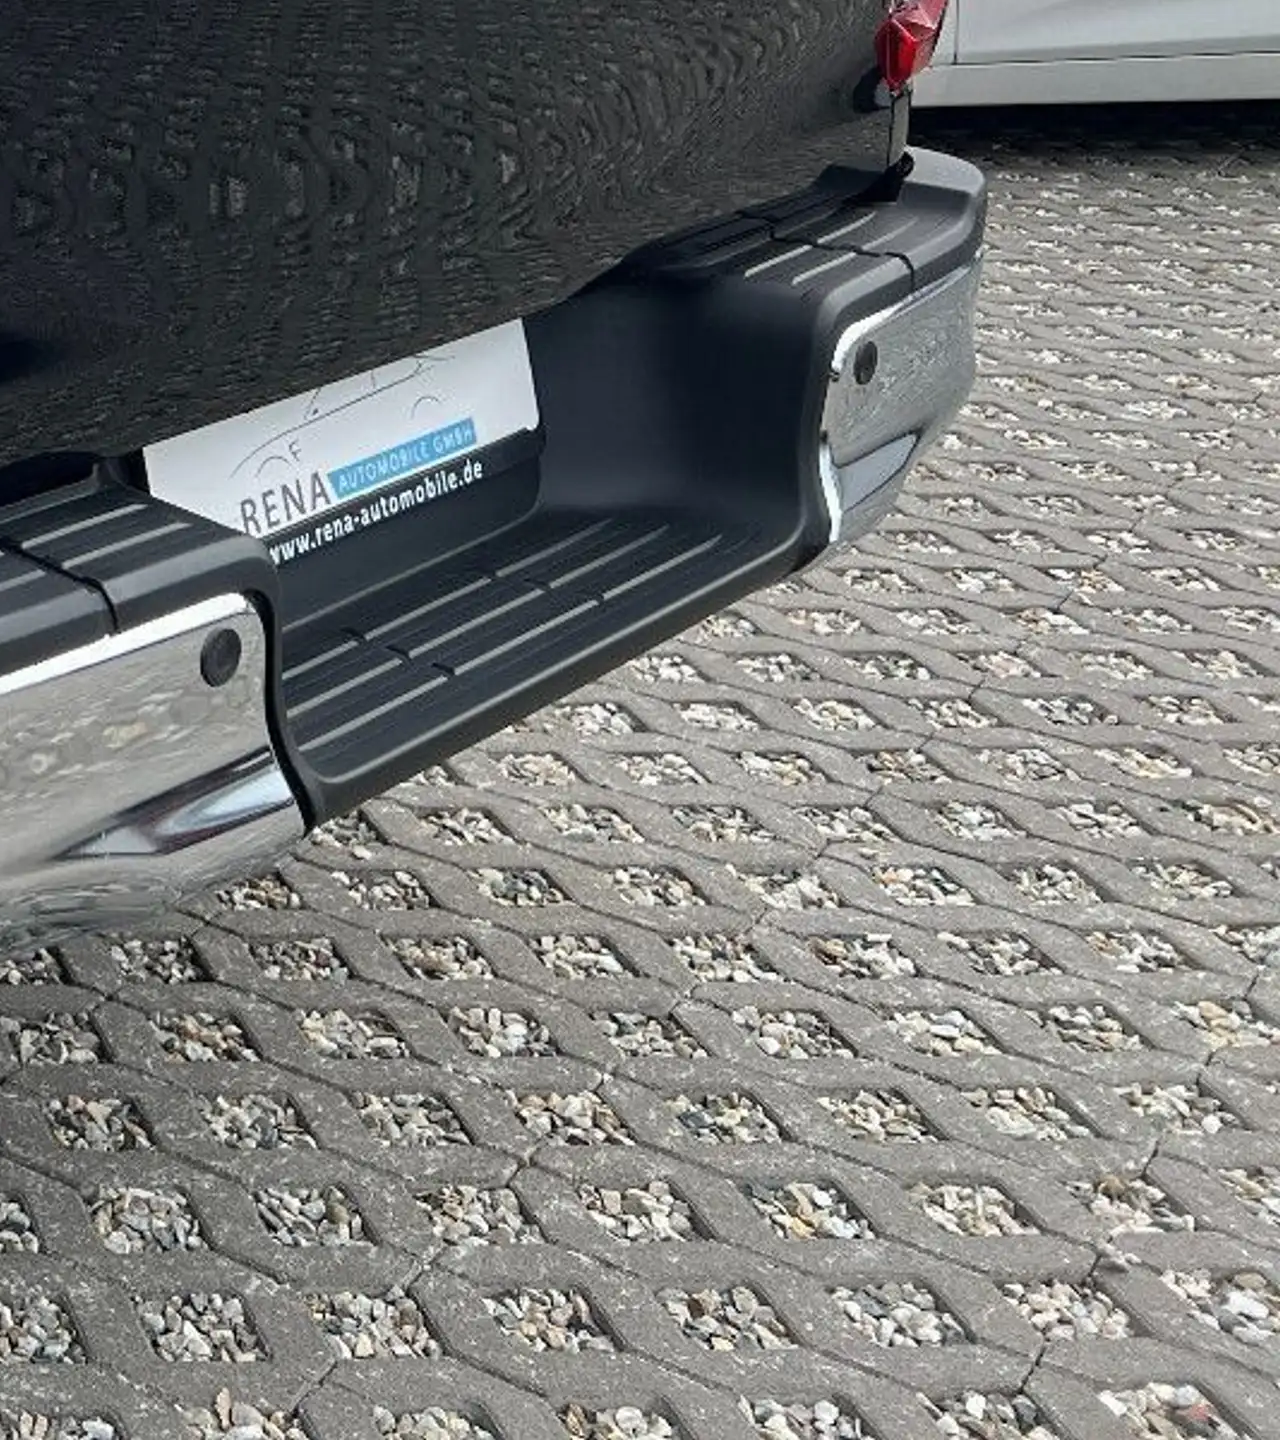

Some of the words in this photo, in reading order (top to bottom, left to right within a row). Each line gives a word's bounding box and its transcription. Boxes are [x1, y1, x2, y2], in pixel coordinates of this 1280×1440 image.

[240, 469, 332, 535] RENA
[338, 440, 431, 495] AUTOMOBILE
[268, 458, 484, 566] www.rena-automobile.de
